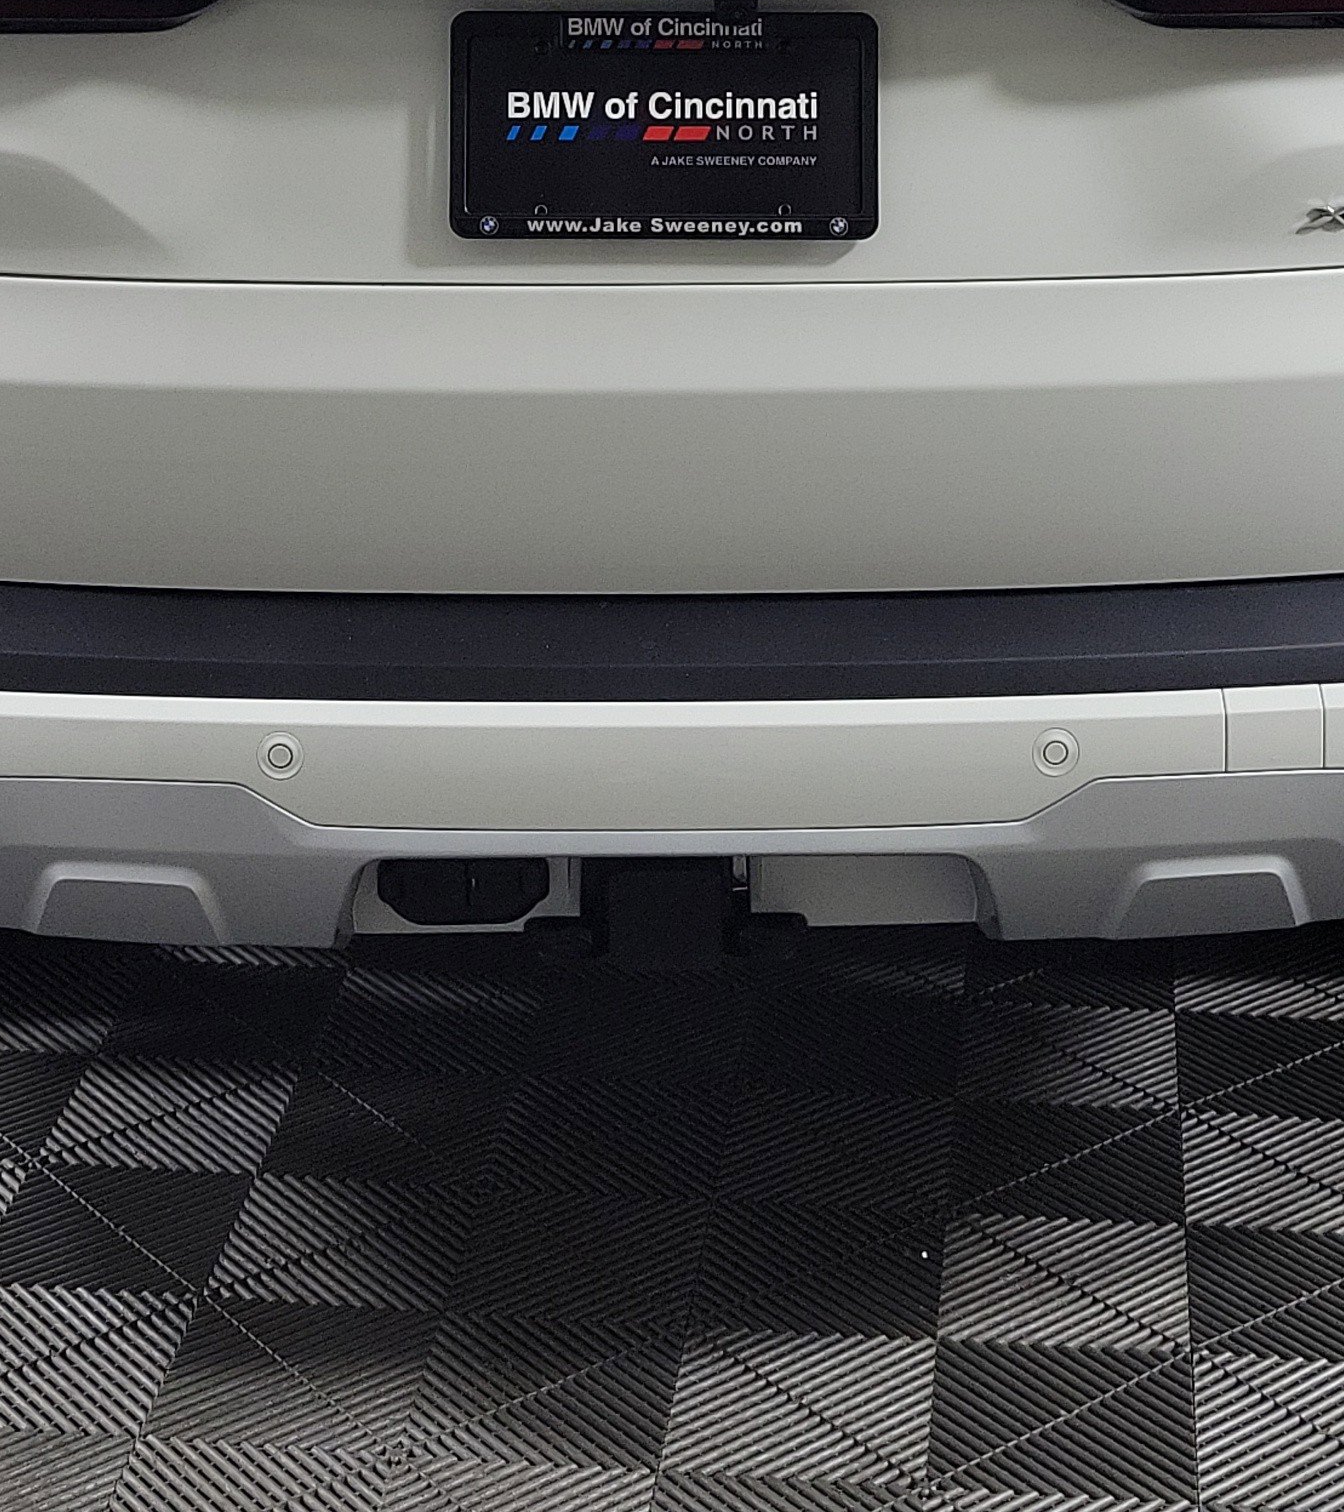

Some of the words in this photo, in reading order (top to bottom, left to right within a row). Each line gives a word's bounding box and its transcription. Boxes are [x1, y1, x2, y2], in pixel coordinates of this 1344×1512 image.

[568, 18, 624, 36] BMW
[631, 17, 652, 36] of
[712, 40, 763, 49] NORTH
[508, 93, 593, 119] BMW
[605, 92, 638, 119] of
[649, 92, 817, 119] Cincinnati
[716, 126, 817, 141] NORTH
[651, 156, 659, 166] A
[662, 156, 694, 166] JAKE
[696, 156, 755, 166] SWEENEY
[758, 156, 817, 166] COMPANY
[527, 219, 642, 233] www.Jake
[651, 218, 802, 235] Sweeney.com
